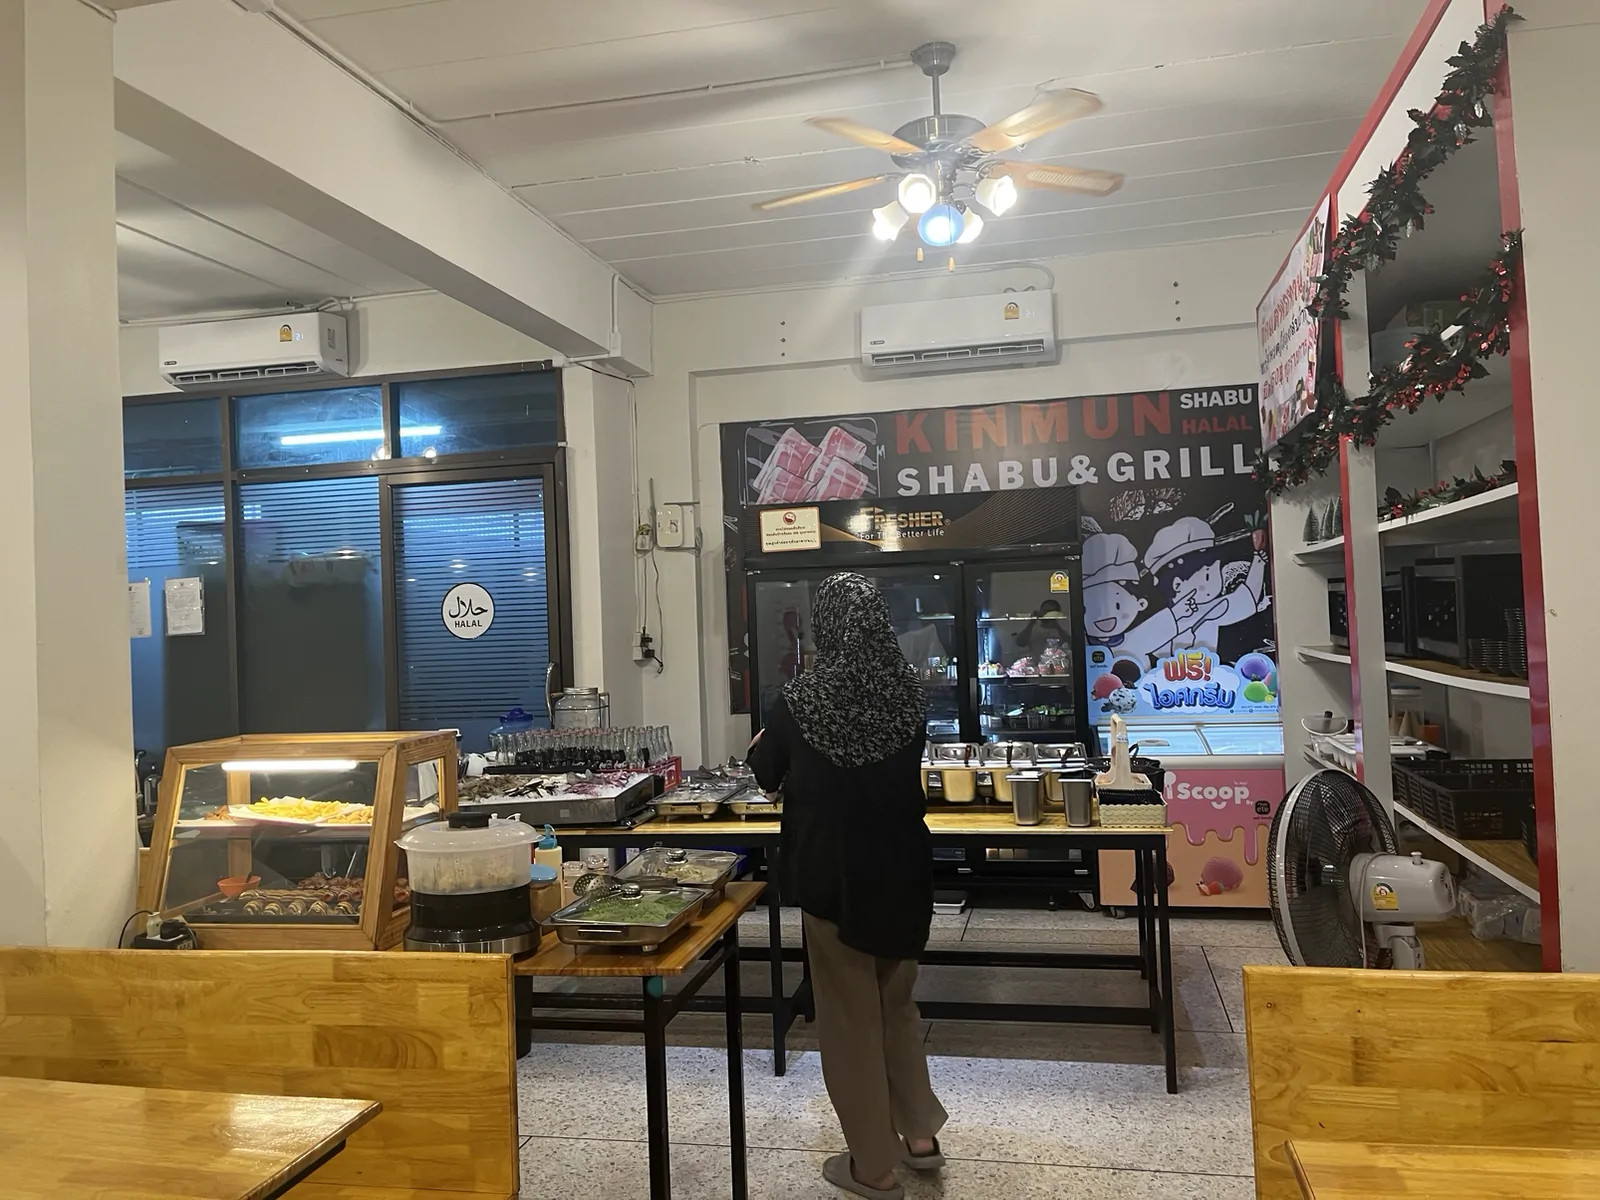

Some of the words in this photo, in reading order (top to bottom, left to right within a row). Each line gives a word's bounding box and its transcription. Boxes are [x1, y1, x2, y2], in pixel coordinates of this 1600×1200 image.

[1180, 388, 1252, 409] SHABU
[894, 393, 1172, 455] KINMUN
[1181, 411, 1253, 434] HALAL
[897, 530, 924, 538] Better
[928, 528, 945, 536] Life
[448, 596, 488, 618] حلال
[454, 620, 482, 628] HALAL
[1164, 651, 1211, 681] ฟรี!
[1144, 682, 1236, 710] ไอศกรีม
